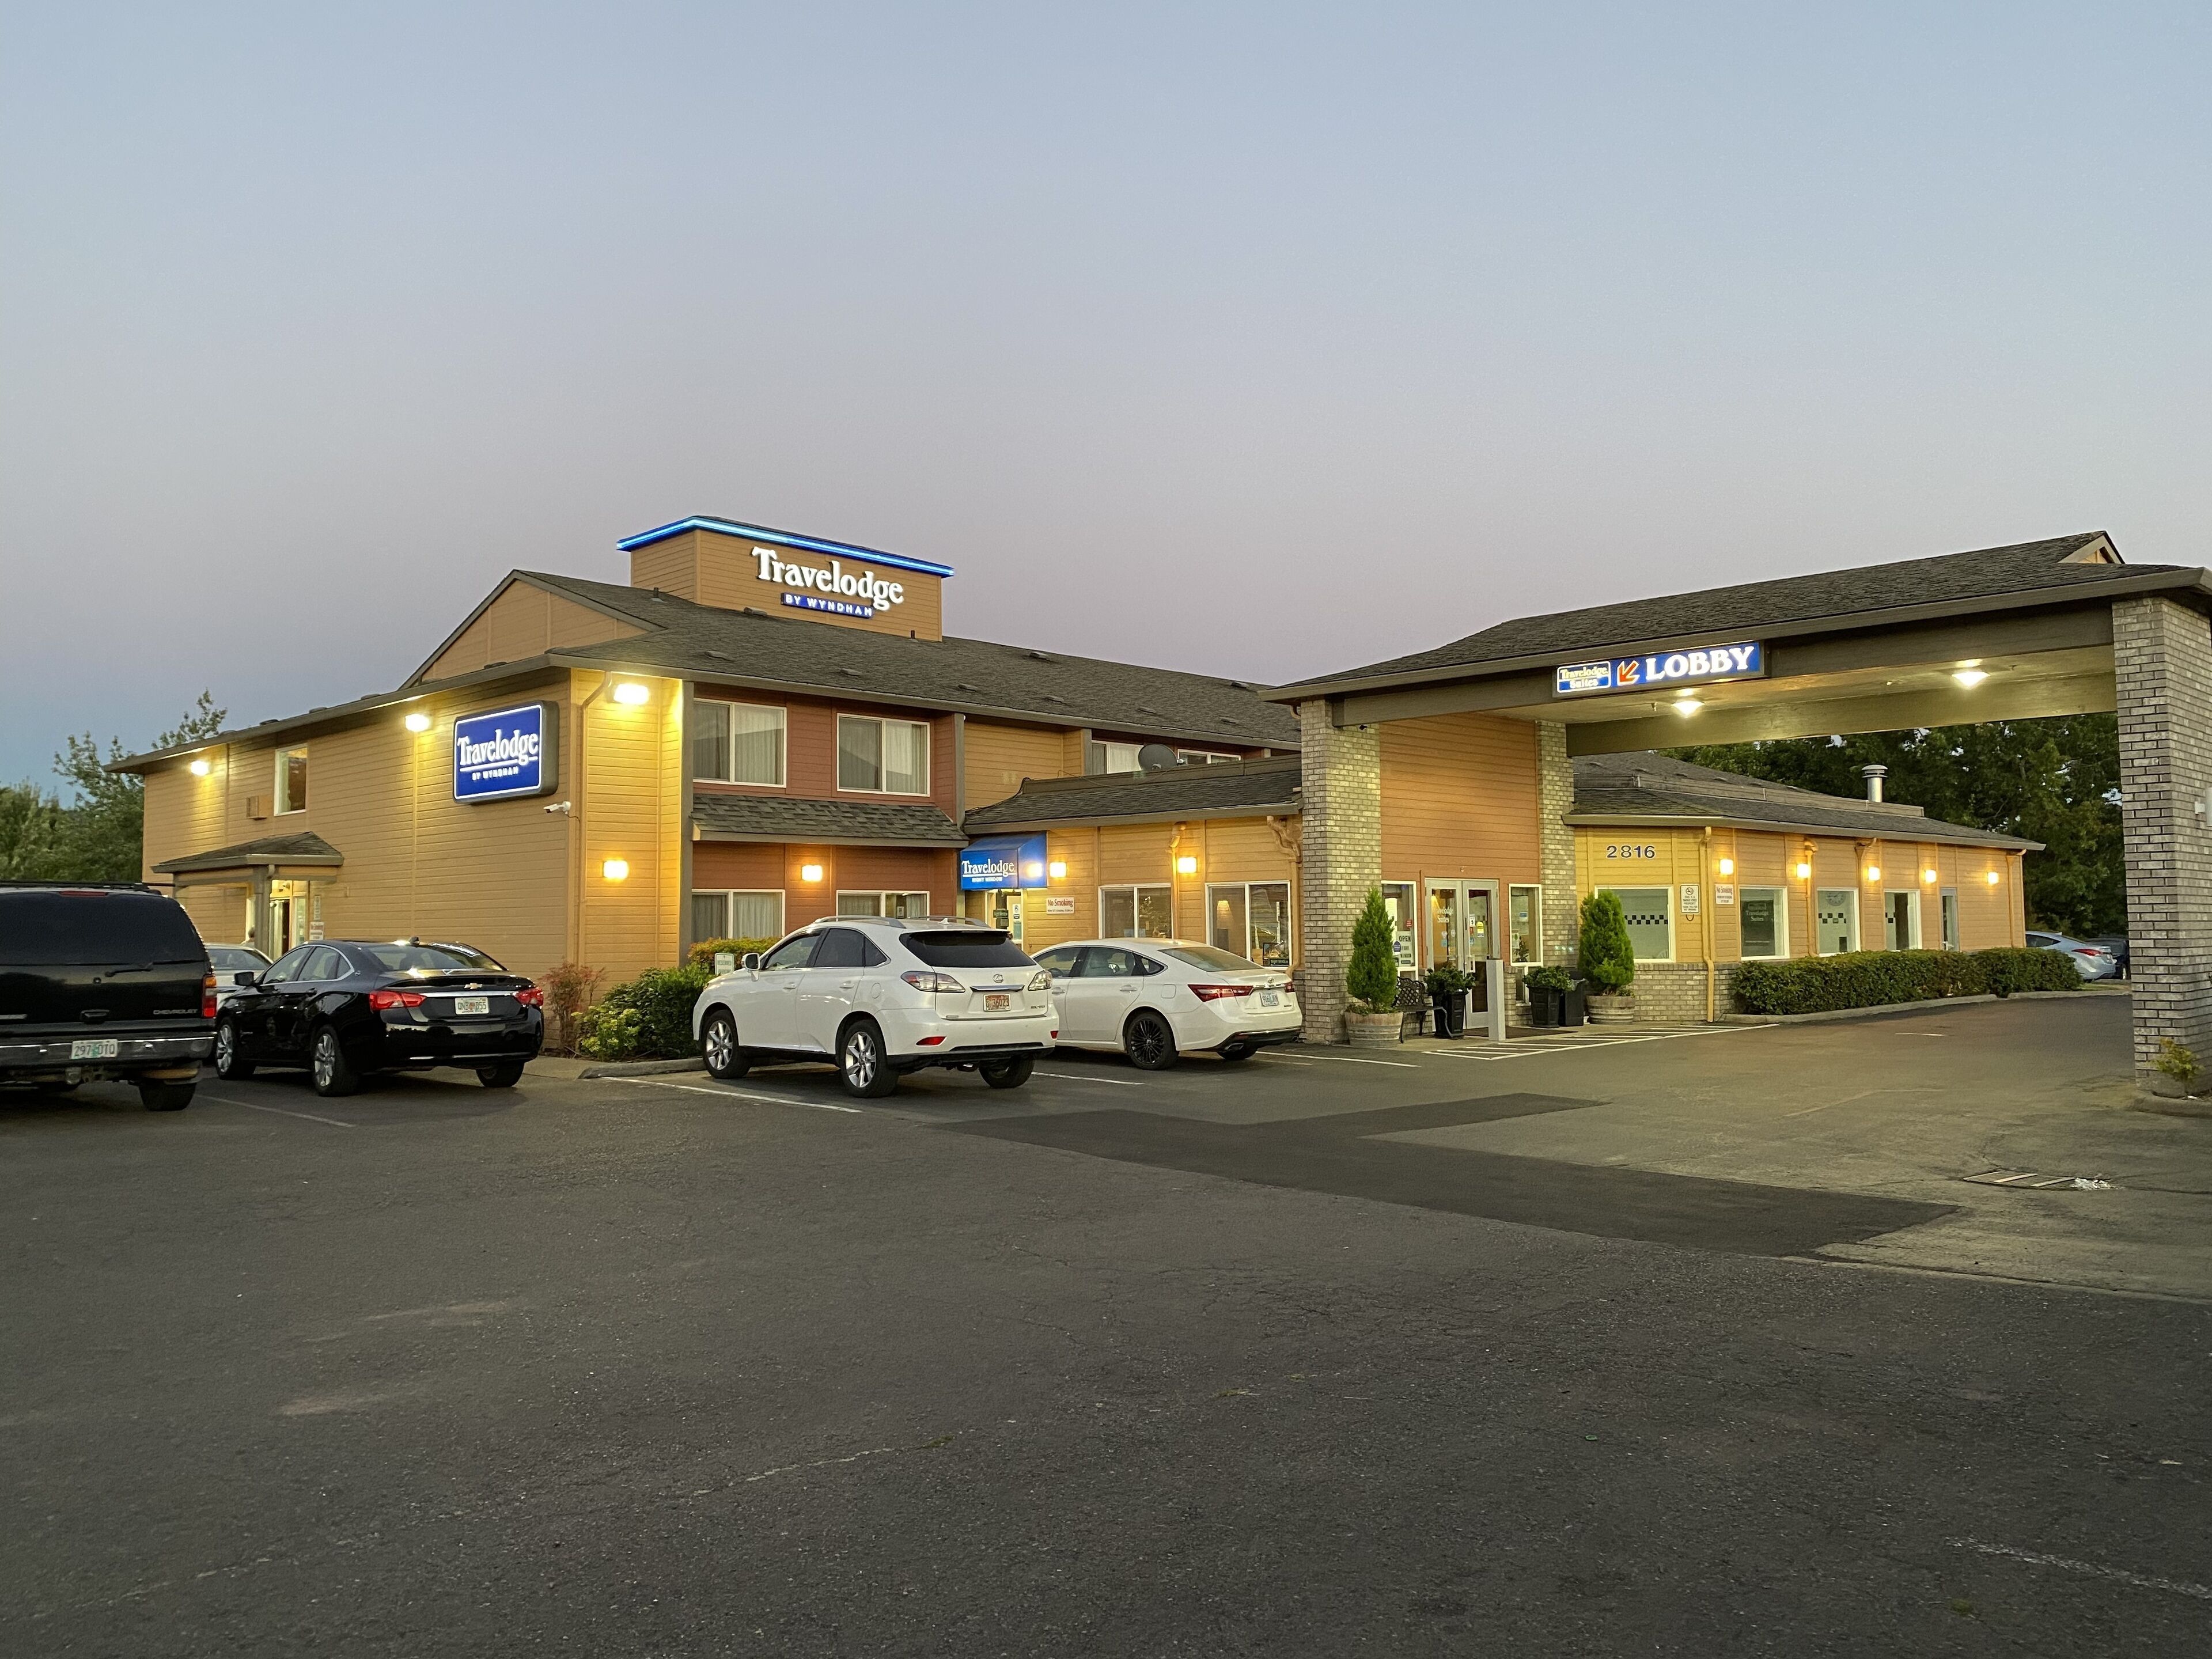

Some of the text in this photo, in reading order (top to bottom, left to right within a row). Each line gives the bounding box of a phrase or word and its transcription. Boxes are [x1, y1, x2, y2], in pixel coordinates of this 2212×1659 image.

[751, 546, 904, 611] Travelodge
[785, 593, 872, 616] BY WYNDHAM
[1645, 646, 1755, 681] LOBBY
[1560, 666, 1608, 679] Travelodge
[1570, 679, 1599, 688] Suites
[457, 729, 539, 766] Travelodge
[472, 766, 518, 781] BY WYNDHAM
[1606, 844, 1656, 859] 2816
[961, 858, 1014, 877] Travelodge
[1054, 899, 1073, 907] Smoking
[74, 1045, 92, 1056] 297
